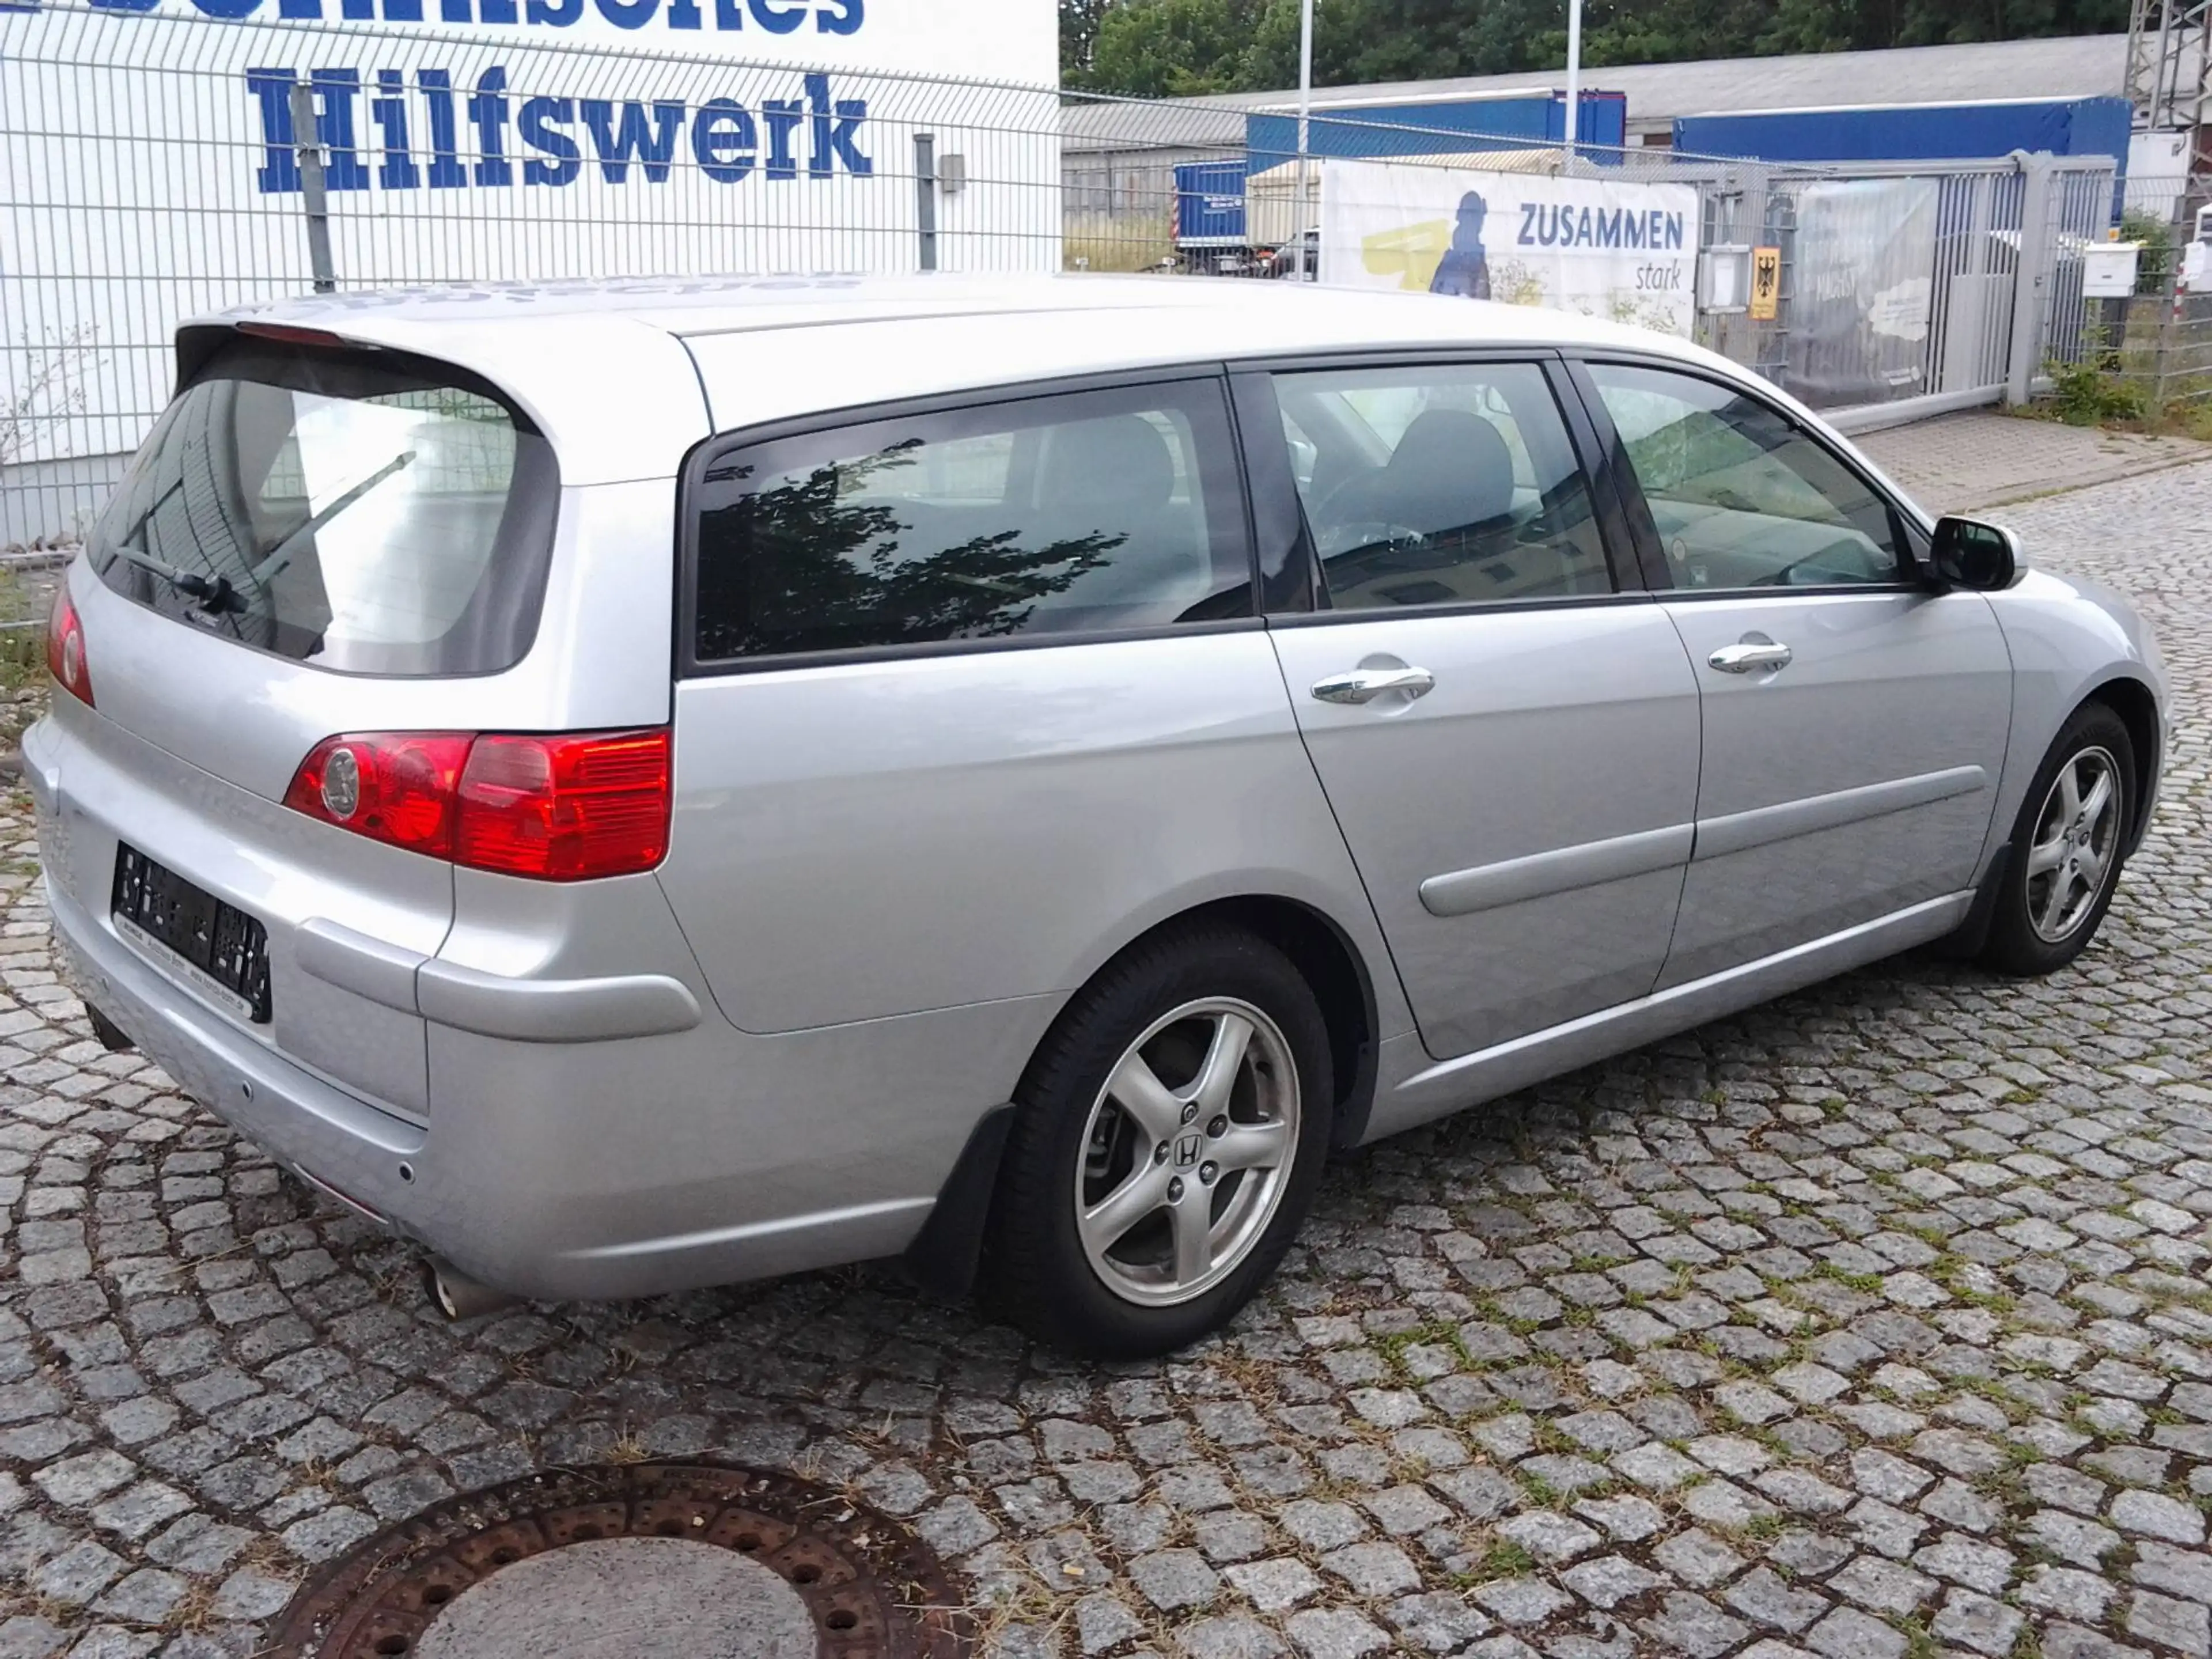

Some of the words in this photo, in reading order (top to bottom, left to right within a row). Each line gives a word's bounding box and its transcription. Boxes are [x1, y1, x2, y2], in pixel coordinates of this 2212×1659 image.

[247, 66, 873, 193] Hilfswerk
[1517, 203, 1683, 250] ZUSAMMEN
[1635, 258, 1681, 290] stark
